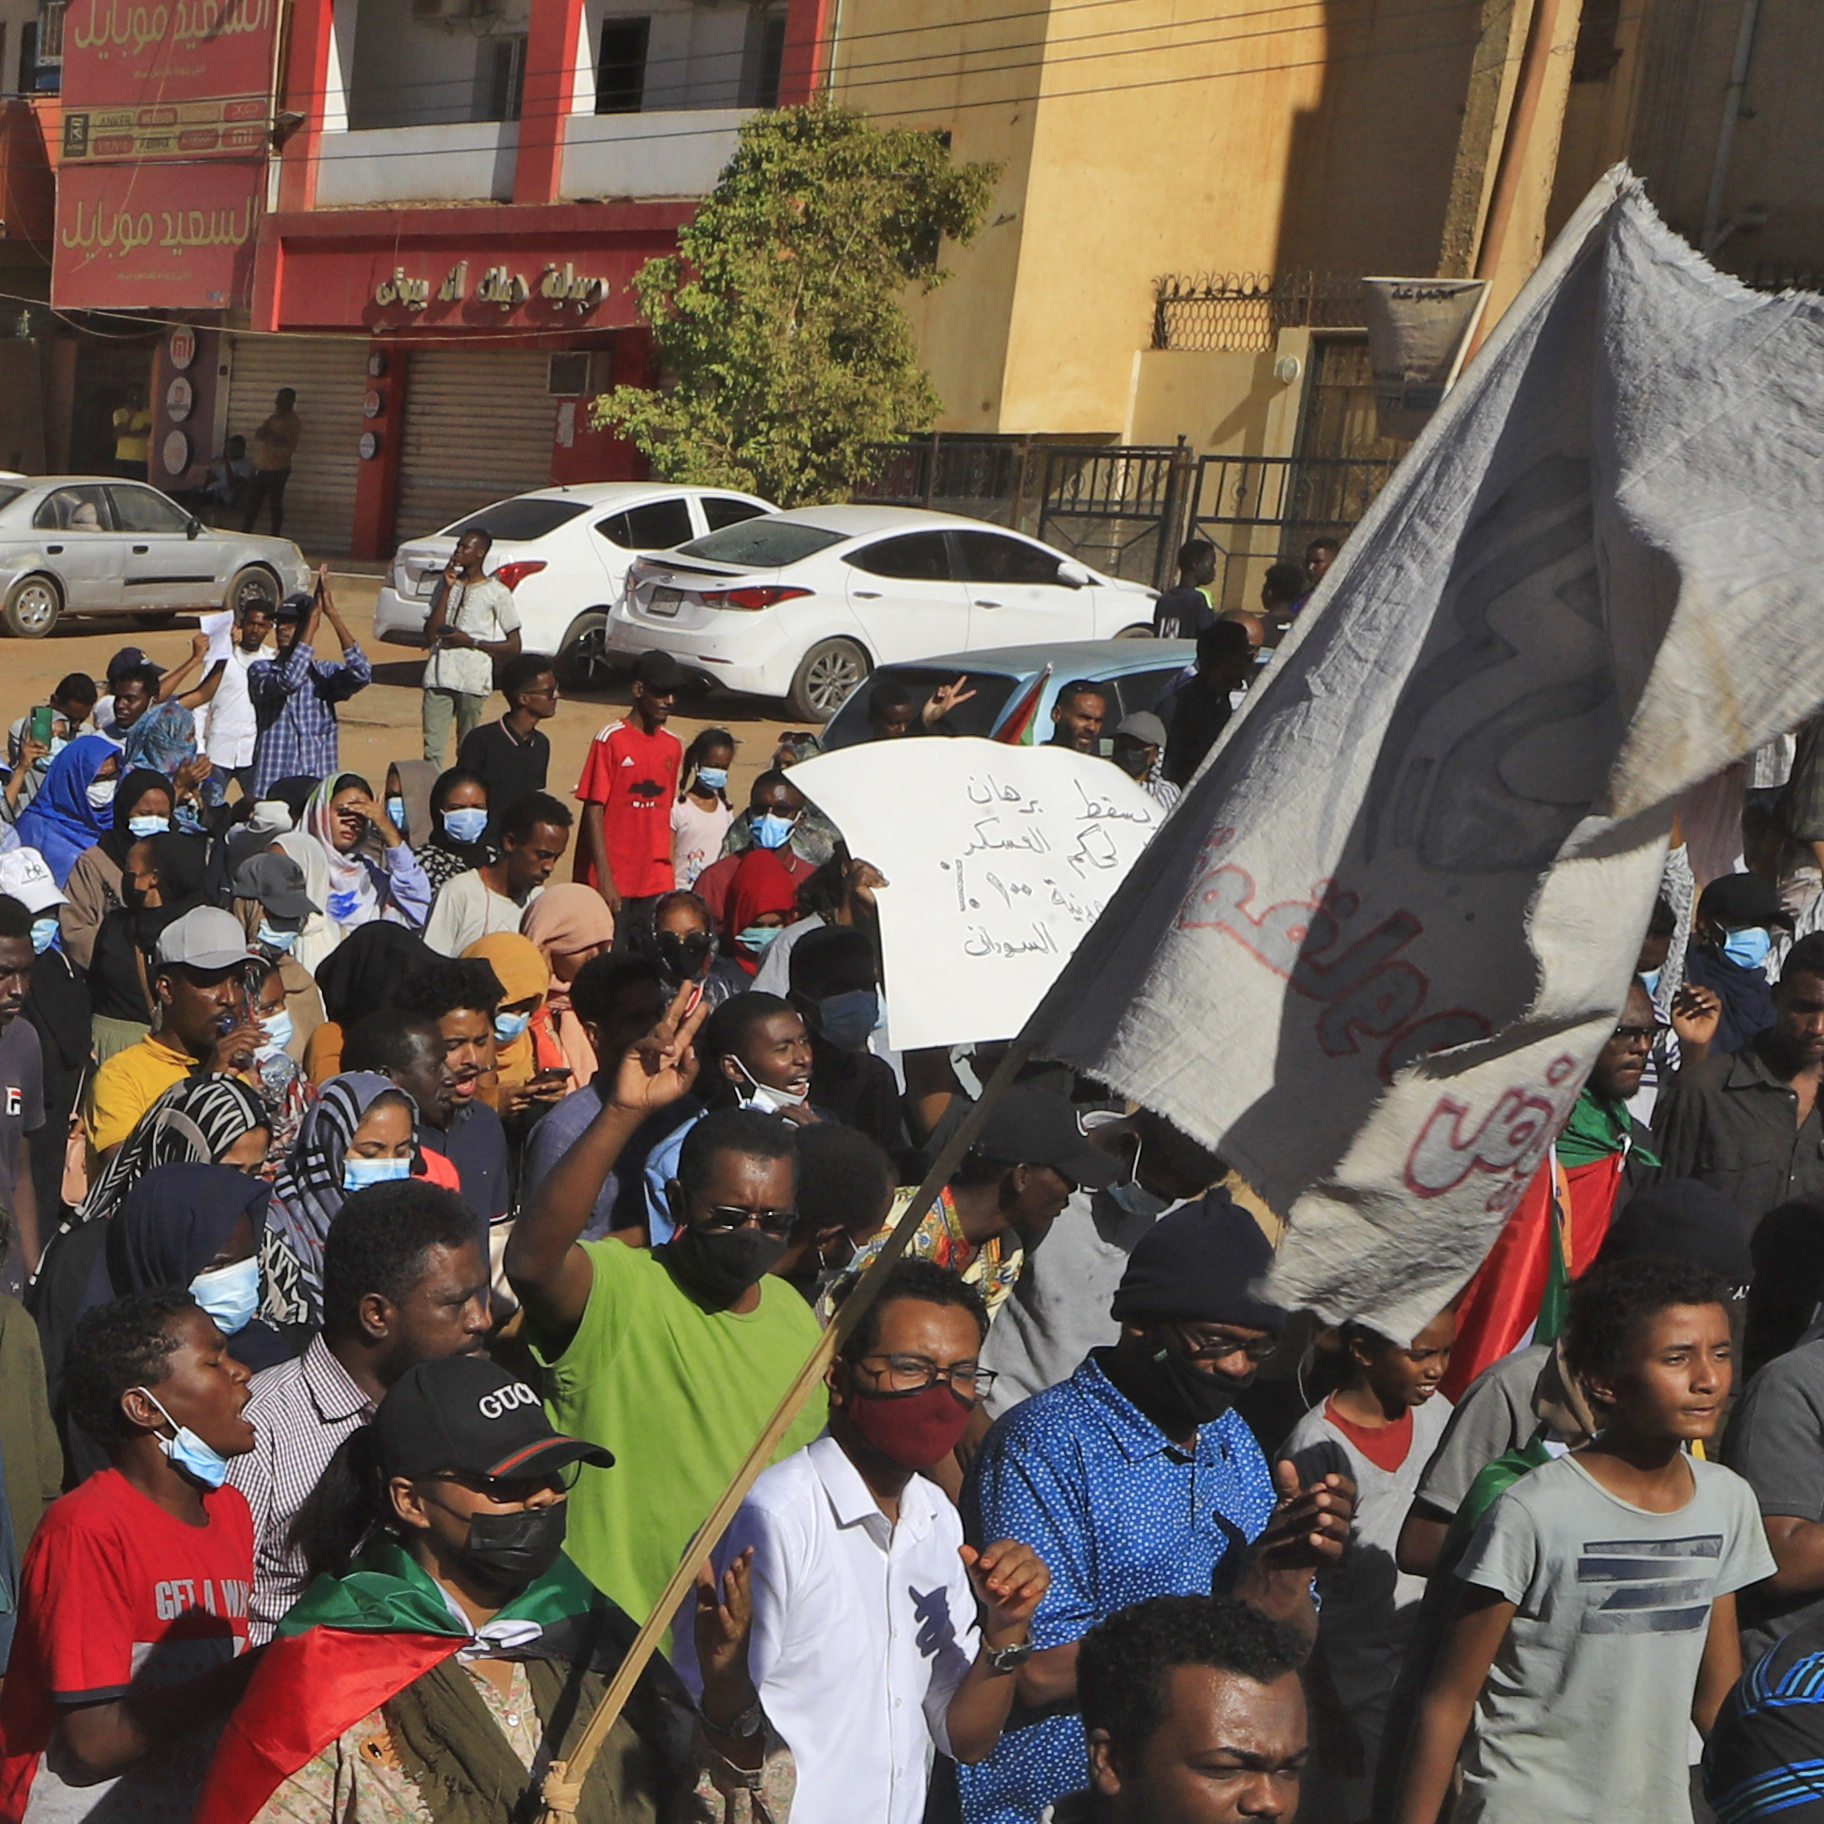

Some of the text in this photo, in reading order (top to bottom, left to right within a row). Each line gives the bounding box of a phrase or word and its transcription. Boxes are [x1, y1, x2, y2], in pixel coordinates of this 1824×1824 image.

[62, 195, 259, 259] السعيد موبايل
[967, 773, 1044, 814] برهان
[963, 816, 1052, 857] العسكر
[155, 1579, 217, 1620] GET A
